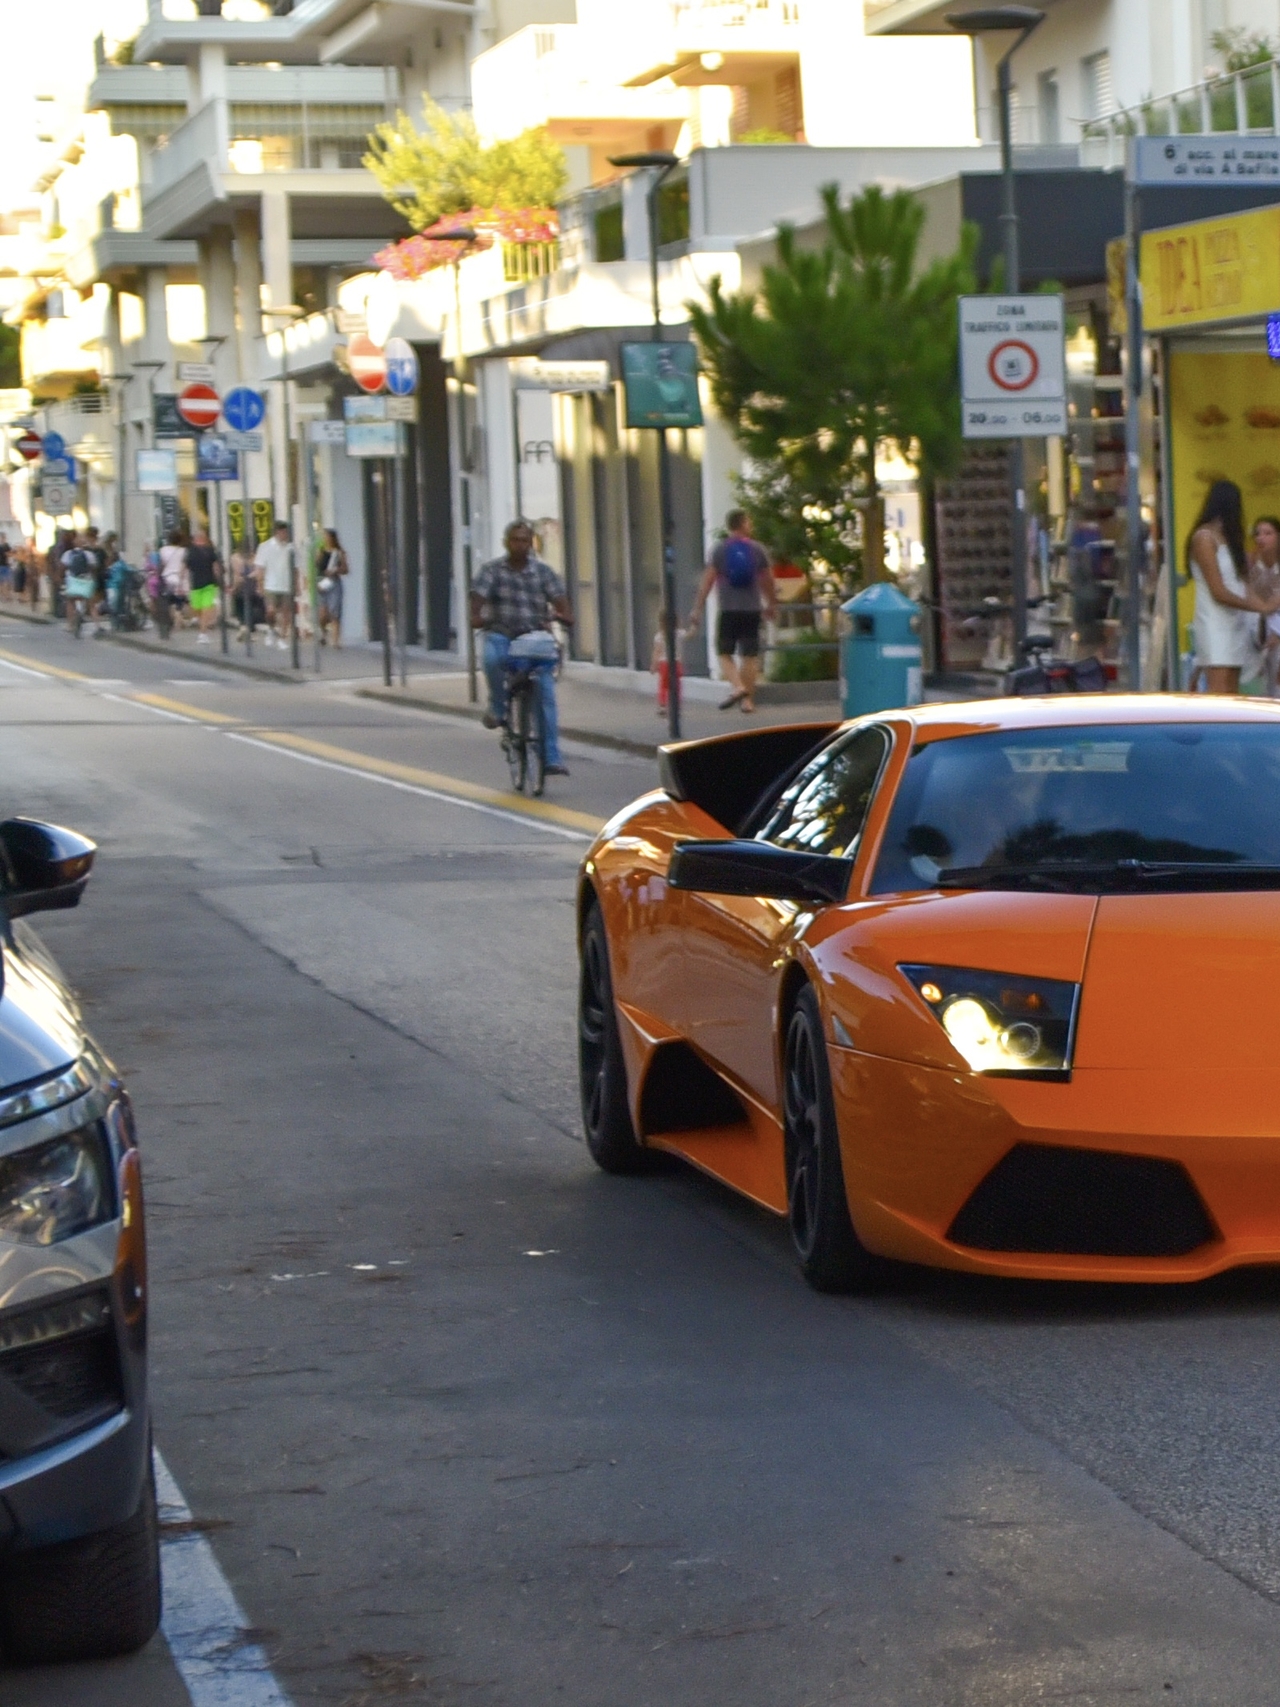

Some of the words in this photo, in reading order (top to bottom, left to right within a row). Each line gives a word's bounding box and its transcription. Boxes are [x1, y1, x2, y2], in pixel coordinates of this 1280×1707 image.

[1223, 148, 1236, 160] al
[1243, 150, 1279, 160] mare
[1174, 162, 1187, 175] di
[1194, 163, 1215, 175] via
